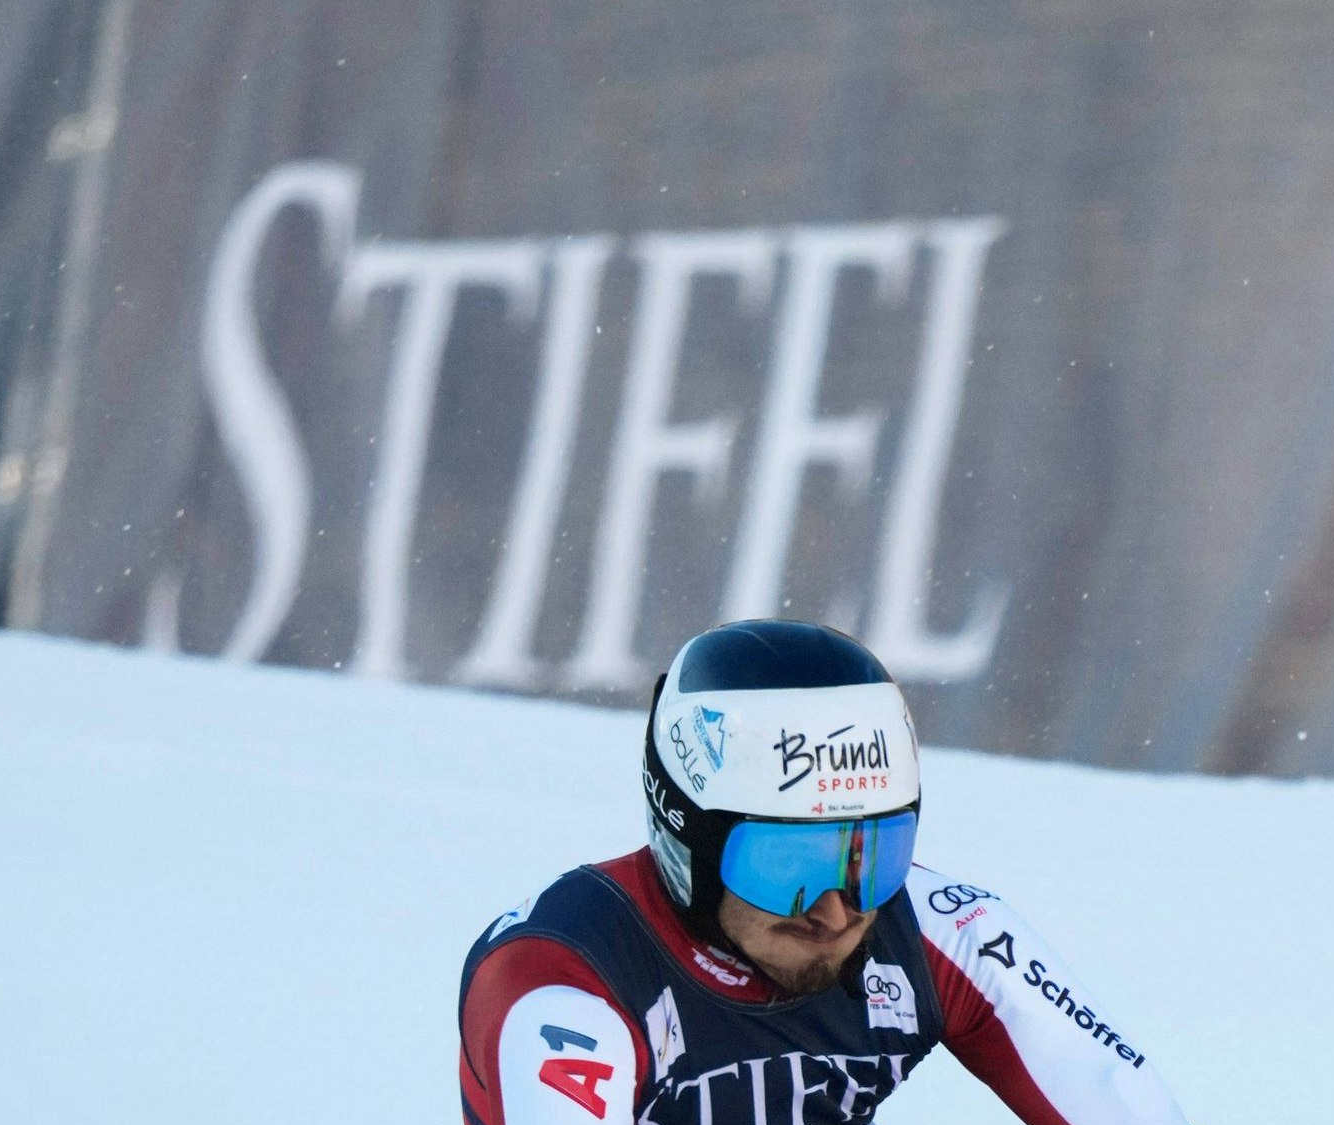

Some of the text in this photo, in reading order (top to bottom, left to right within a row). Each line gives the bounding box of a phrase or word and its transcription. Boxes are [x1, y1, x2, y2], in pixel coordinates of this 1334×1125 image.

[144, 158, 1011, 690] STIFEL
[671, 717, 707, 793] bollé
[818, 776, 888, 792] SPORTS
[955, 906, 987, 931] Audi
[539, 1024, 615, 1120] A1
